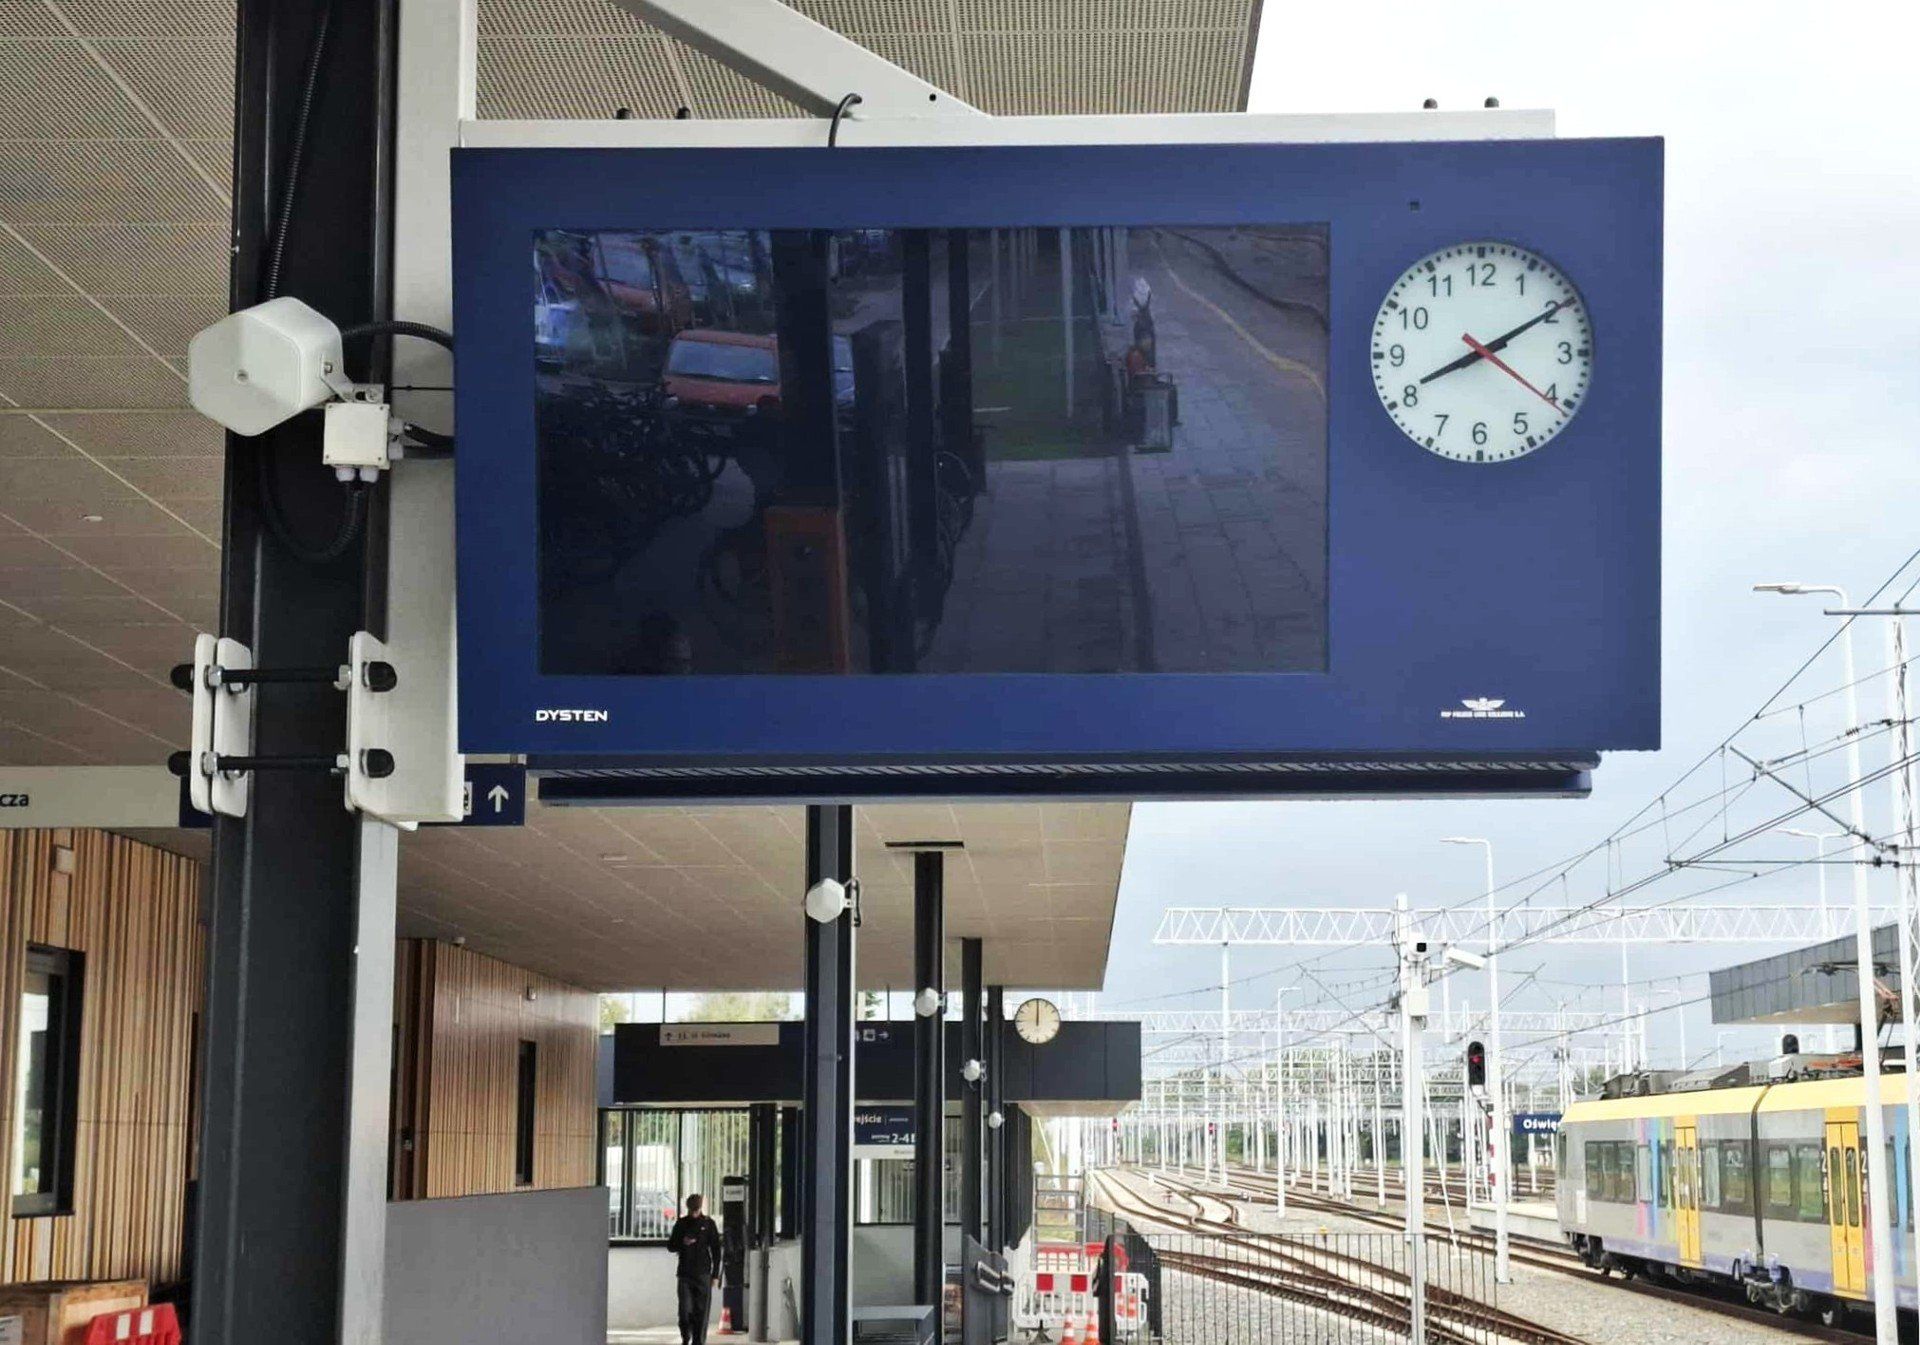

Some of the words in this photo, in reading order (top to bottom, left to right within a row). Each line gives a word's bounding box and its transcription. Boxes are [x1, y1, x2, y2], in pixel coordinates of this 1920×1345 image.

[1427, 274, 1452, 297] 11
[1466, 263, 1497, 287] 12
[1515, 273, 1525, 296] 1
[1398, 306, 1429, 330] 10
[1543, 300, 1559, 324] 2
[1390, 344, 1405, 367] 9
[1557, 341, 1572, 365] 3
[1403, 384, 1418, 408] 8
[1543, 383, 1559, 406] 4
[1434, 414, 1449, 437] 7
[1472, 421, 1487, 445] 6
[1513, 412, 1529, 435] 5
[535, 709, 608, 722] DYSTEN
[0, 794, 29, 807] cza
[854, 1114, 882, 1125] ejście
